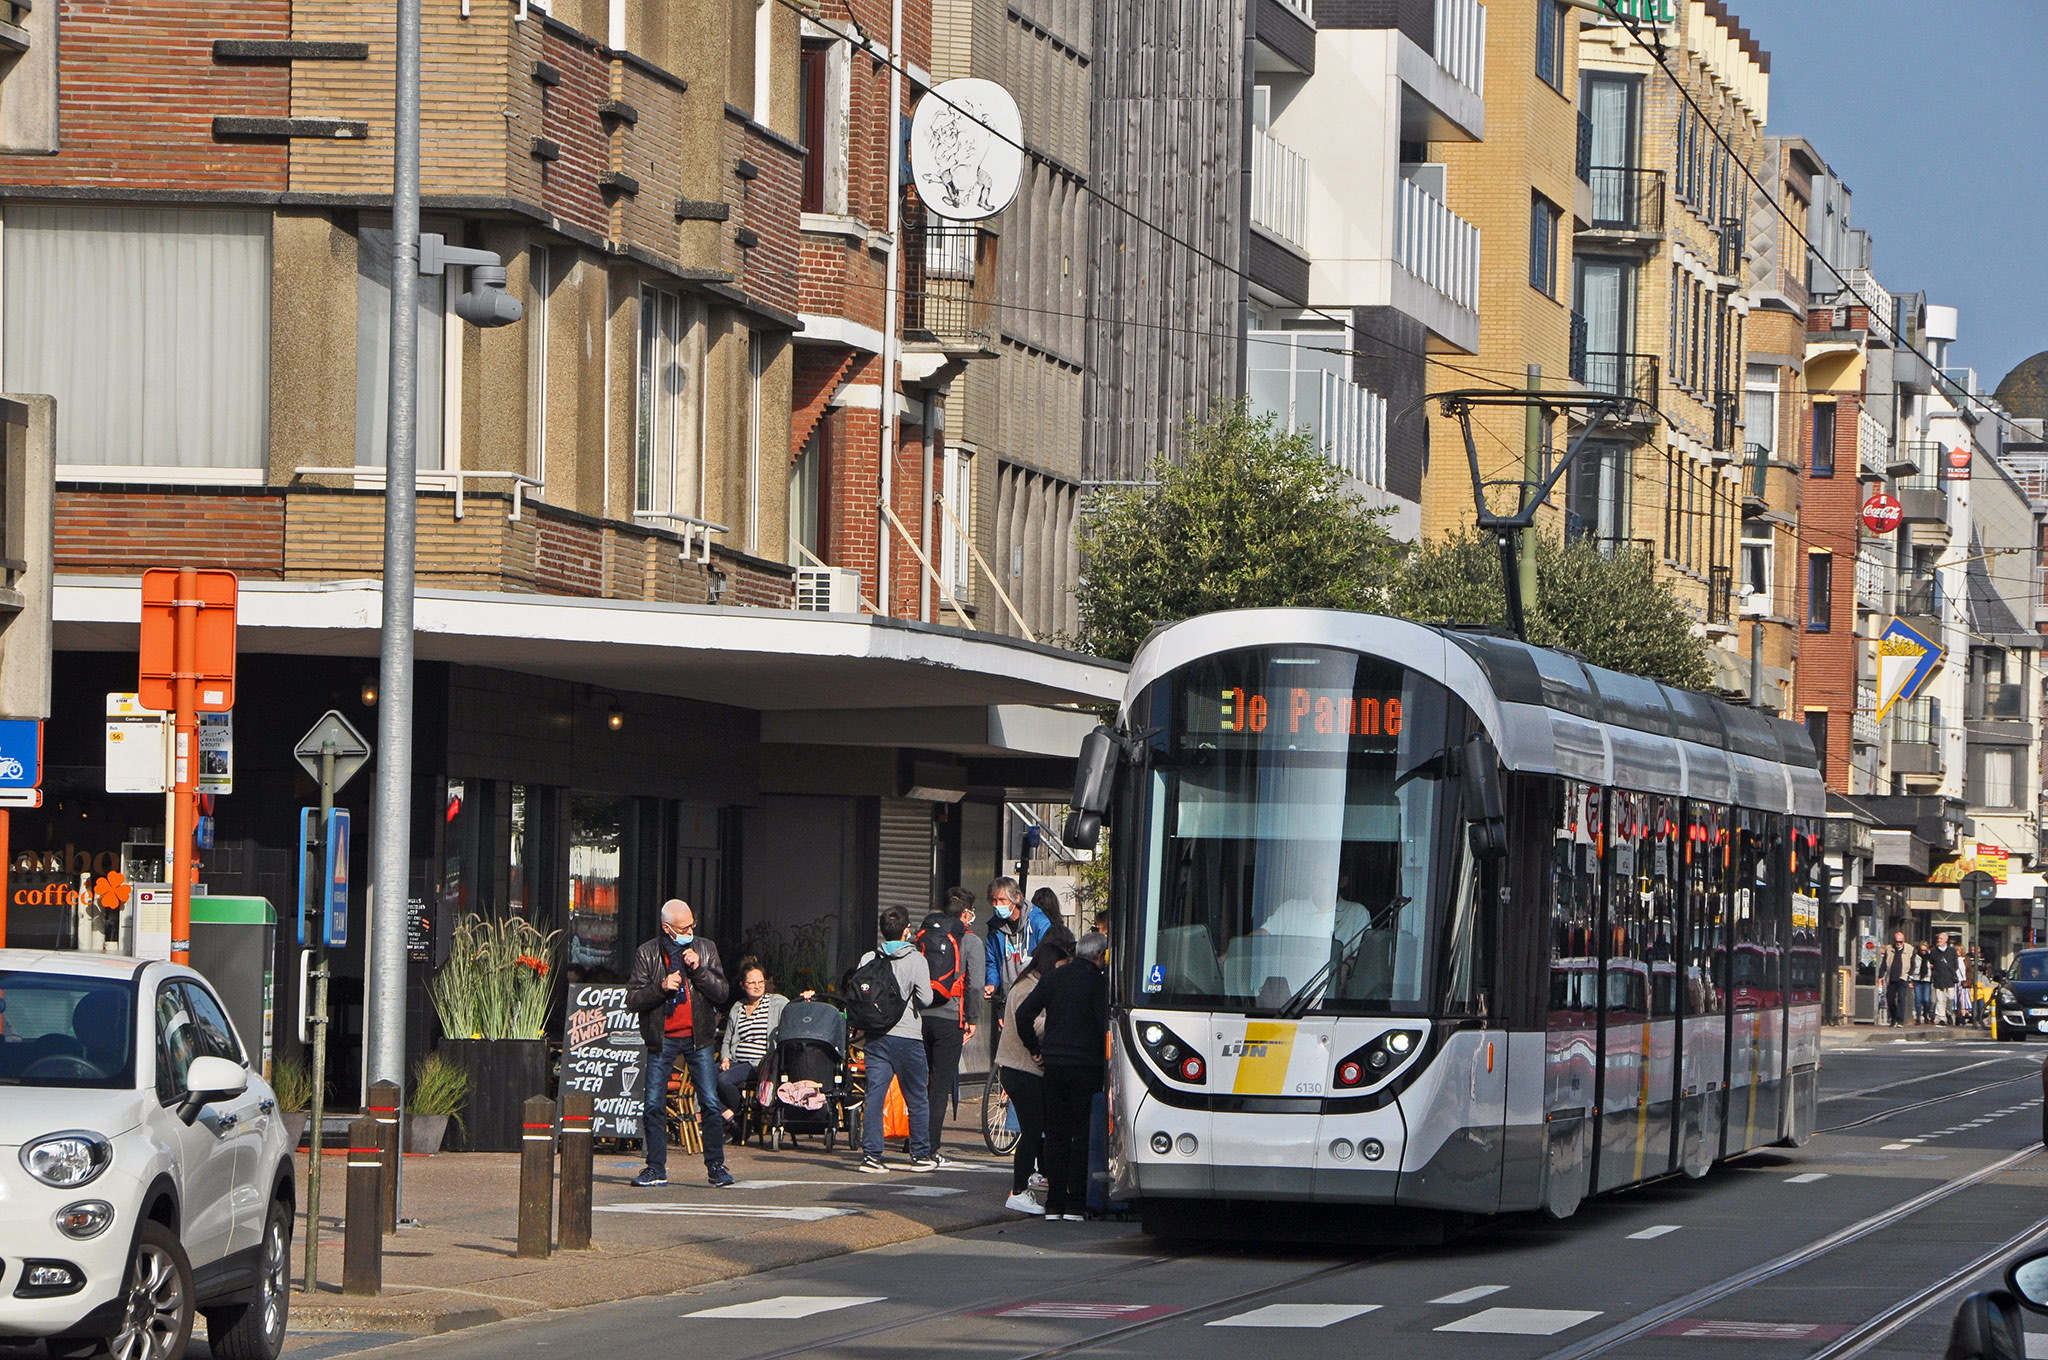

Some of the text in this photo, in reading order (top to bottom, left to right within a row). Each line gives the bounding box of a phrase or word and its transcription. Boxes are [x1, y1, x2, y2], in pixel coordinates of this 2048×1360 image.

[1222, 687, 1402, 735] De Panne
[9, 843, 120, 875] arbo
[14, 883, 93, 906] coffee
[568, 1006, 605, 1030] TAKE
[570, 1020, 607, 1046] AWAY
[1295, 1082, 1322, 1093] 6130
